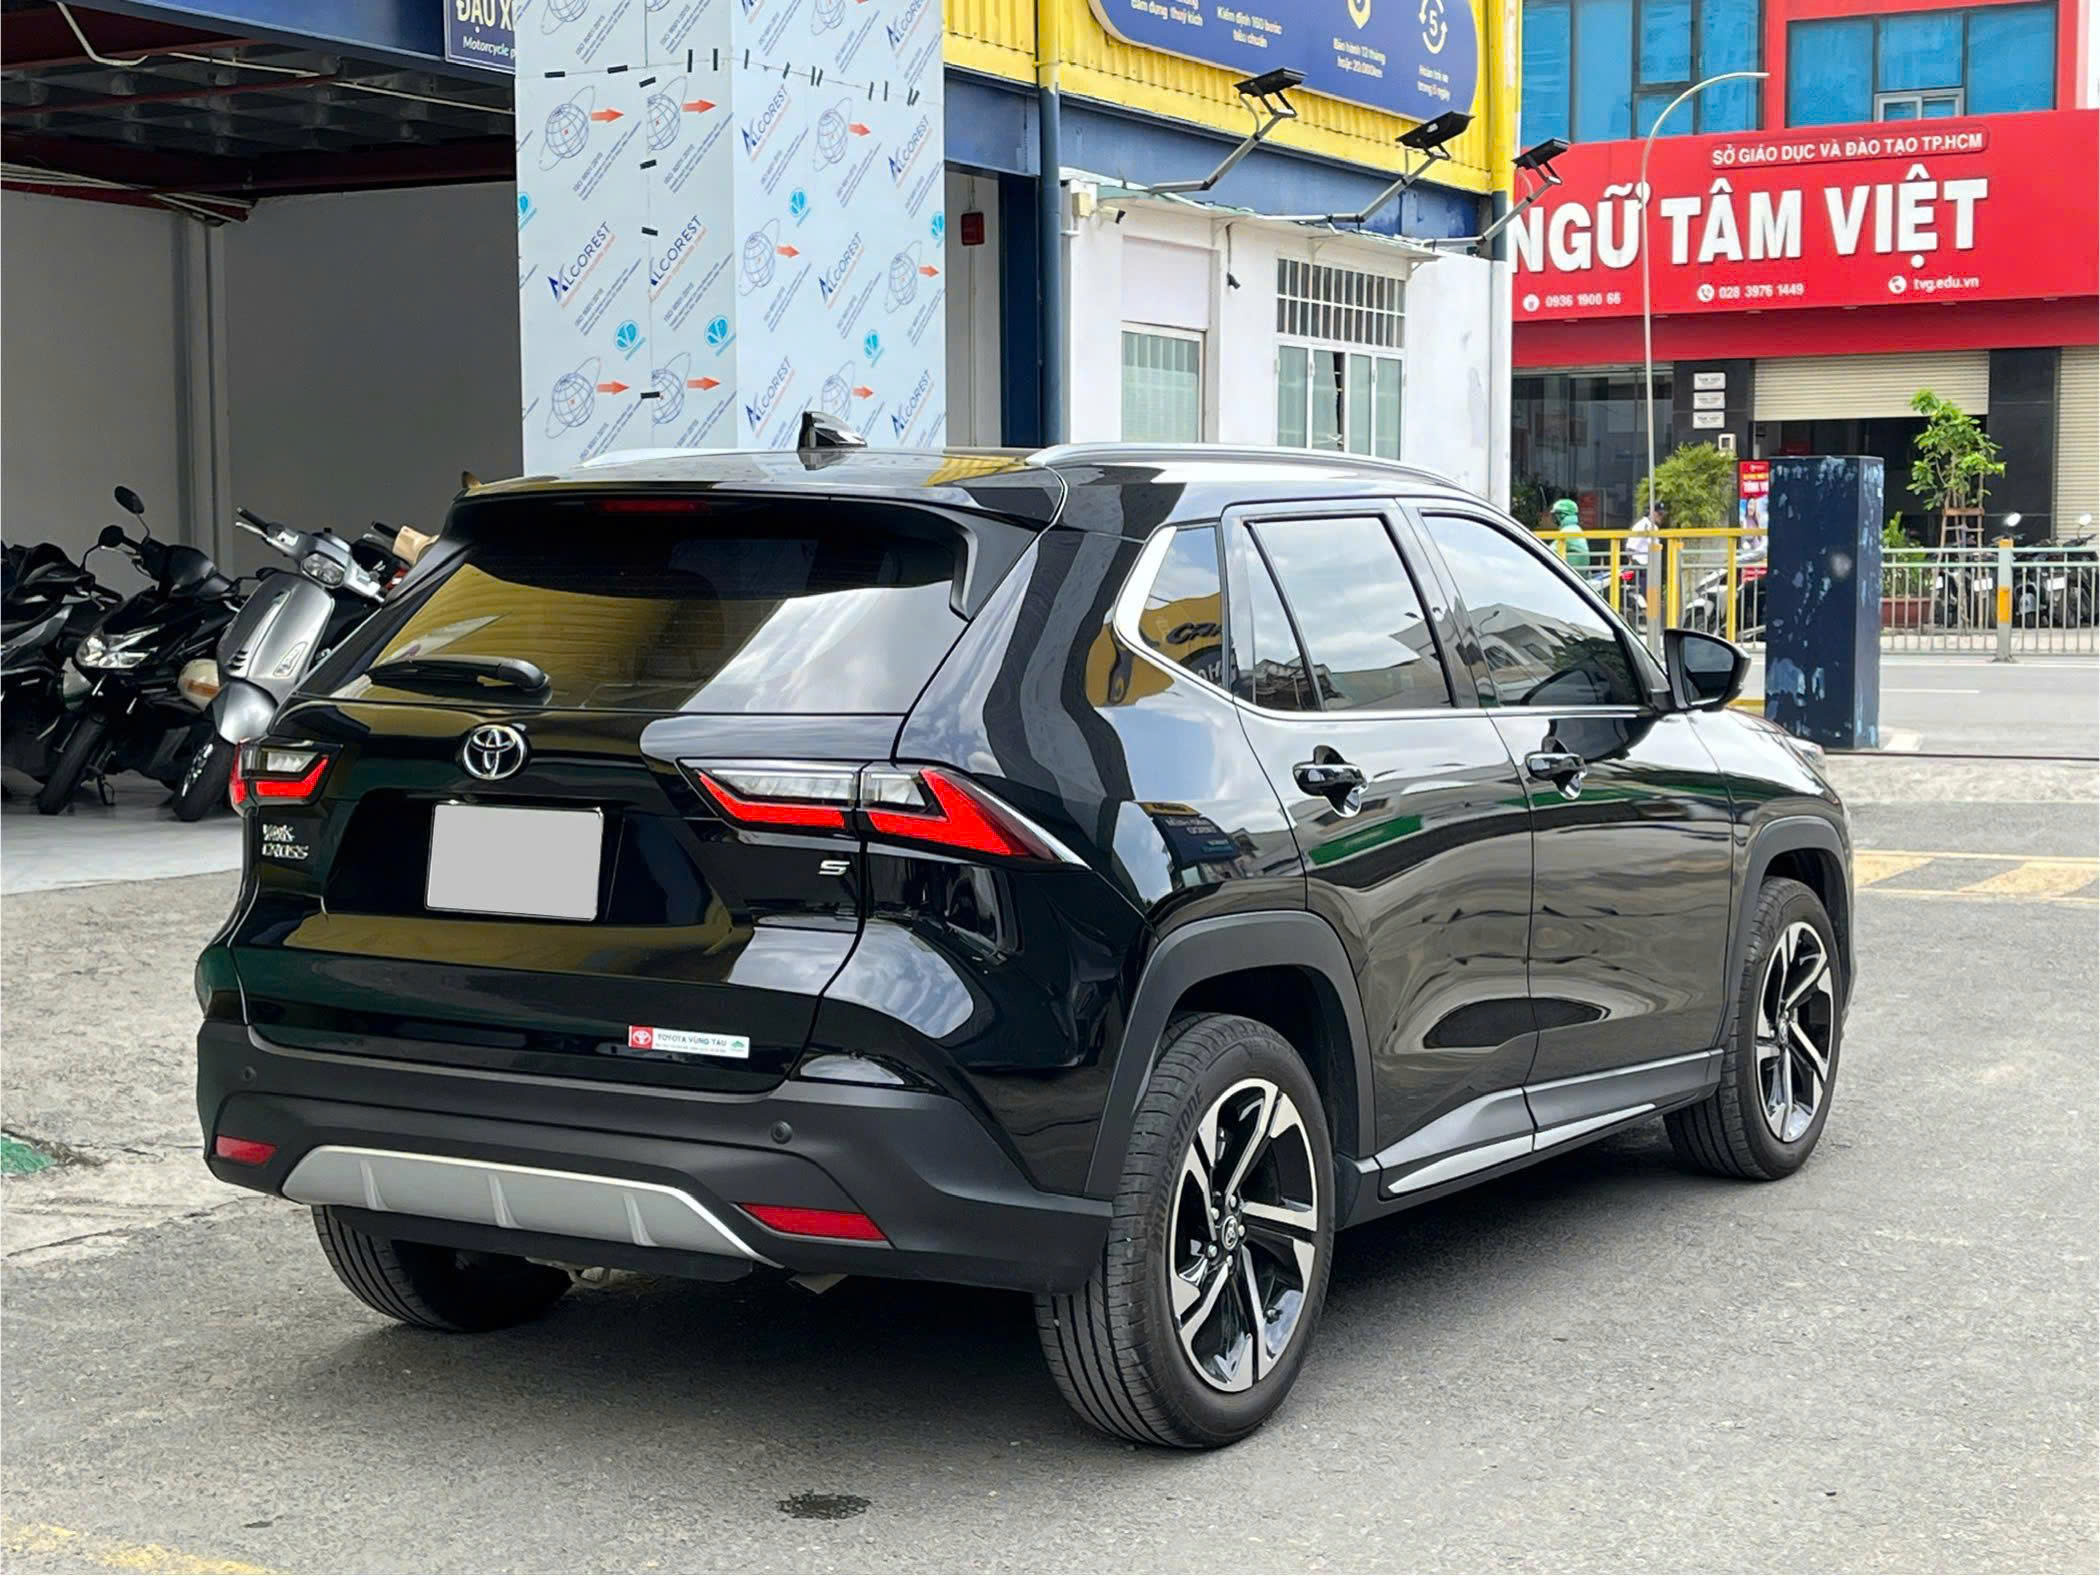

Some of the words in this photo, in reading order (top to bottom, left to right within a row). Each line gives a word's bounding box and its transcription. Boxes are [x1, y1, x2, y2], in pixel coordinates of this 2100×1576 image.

[462, 36, 509, 57] Motorcycle
[741, 83, 790, 158] ALCOREST
[1712, 144, 1735, 165] SỞ
[1739, 142, 1778, 163] GIÁO
[1781, 142, 1816, 163] DỤC
[1820, 136, 1842, 158] VÀ
[1845, 136, 1881, 157] ĐÀO
[1884, 136, 1919, 157] TẠO
[1921, 132, 1983, 152] TP.HCM
[1509, 181, 1651, 273] NGỮ
[1660, 177, 1802, 265] TÂM
[1824, 163, 1988, 269] VIỆT
[547, 221, 611, 302] ALCOREST
[1718, 286, 1740, 299] 028
[1744, 284, 1774, 298] 3976
[1913, 275, 1980, 293] tvg.edu.vn
[818, 860, 851, 876] S
[657, 1033, 687, 1044] TOYOTA
